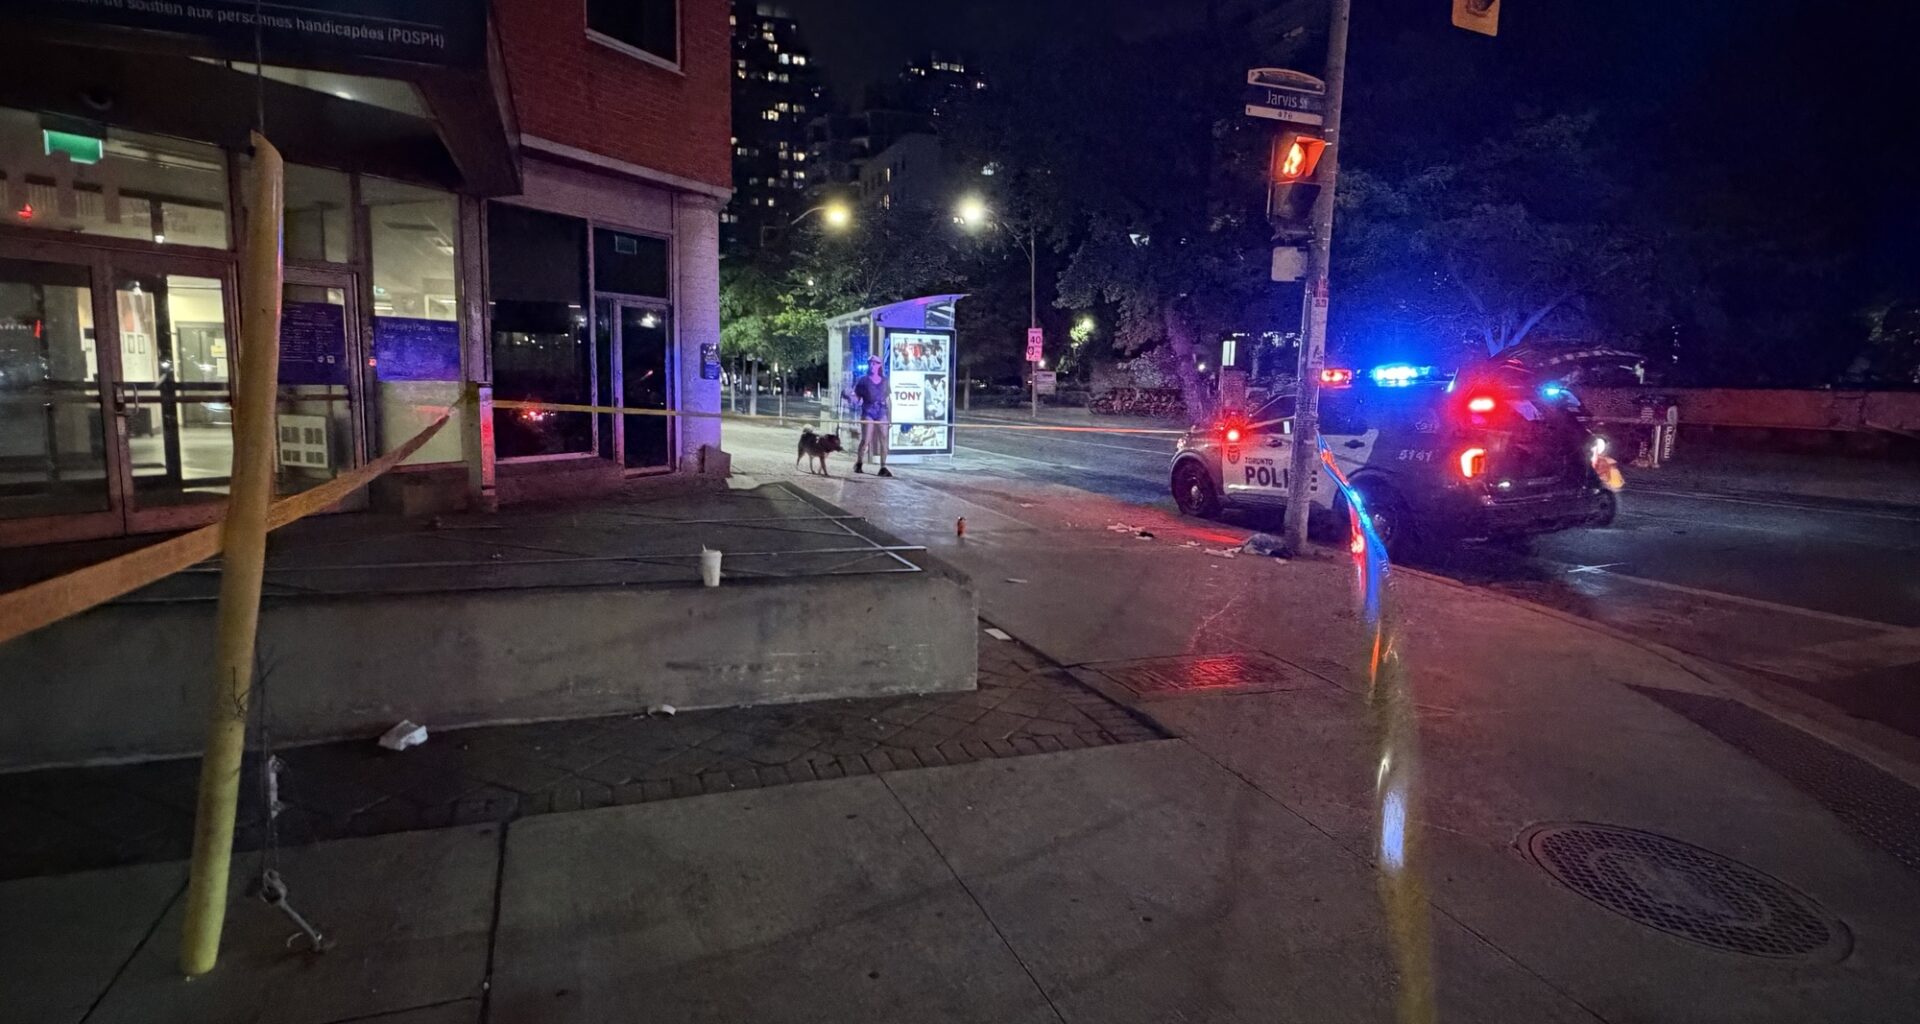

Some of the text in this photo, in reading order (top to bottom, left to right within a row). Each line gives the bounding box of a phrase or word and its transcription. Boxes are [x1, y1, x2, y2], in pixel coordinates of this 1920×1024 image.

[128, 0, 183, 16] soutien
[187, 5, 214, 18] aux
[217, 10, 293, 28] personnes
[296, 16, 385, 40] handicapées
[387, 27, 445, 49] (POSPH)
[1265, 89, 1298, 108] Jarvis
[1030, 336, 1041, 344] 40
[894, 391, 922, 401] TONY
[1244, 456, 1274, 466] TORONTO
[1244, 466, 1317, 491] POLIE
